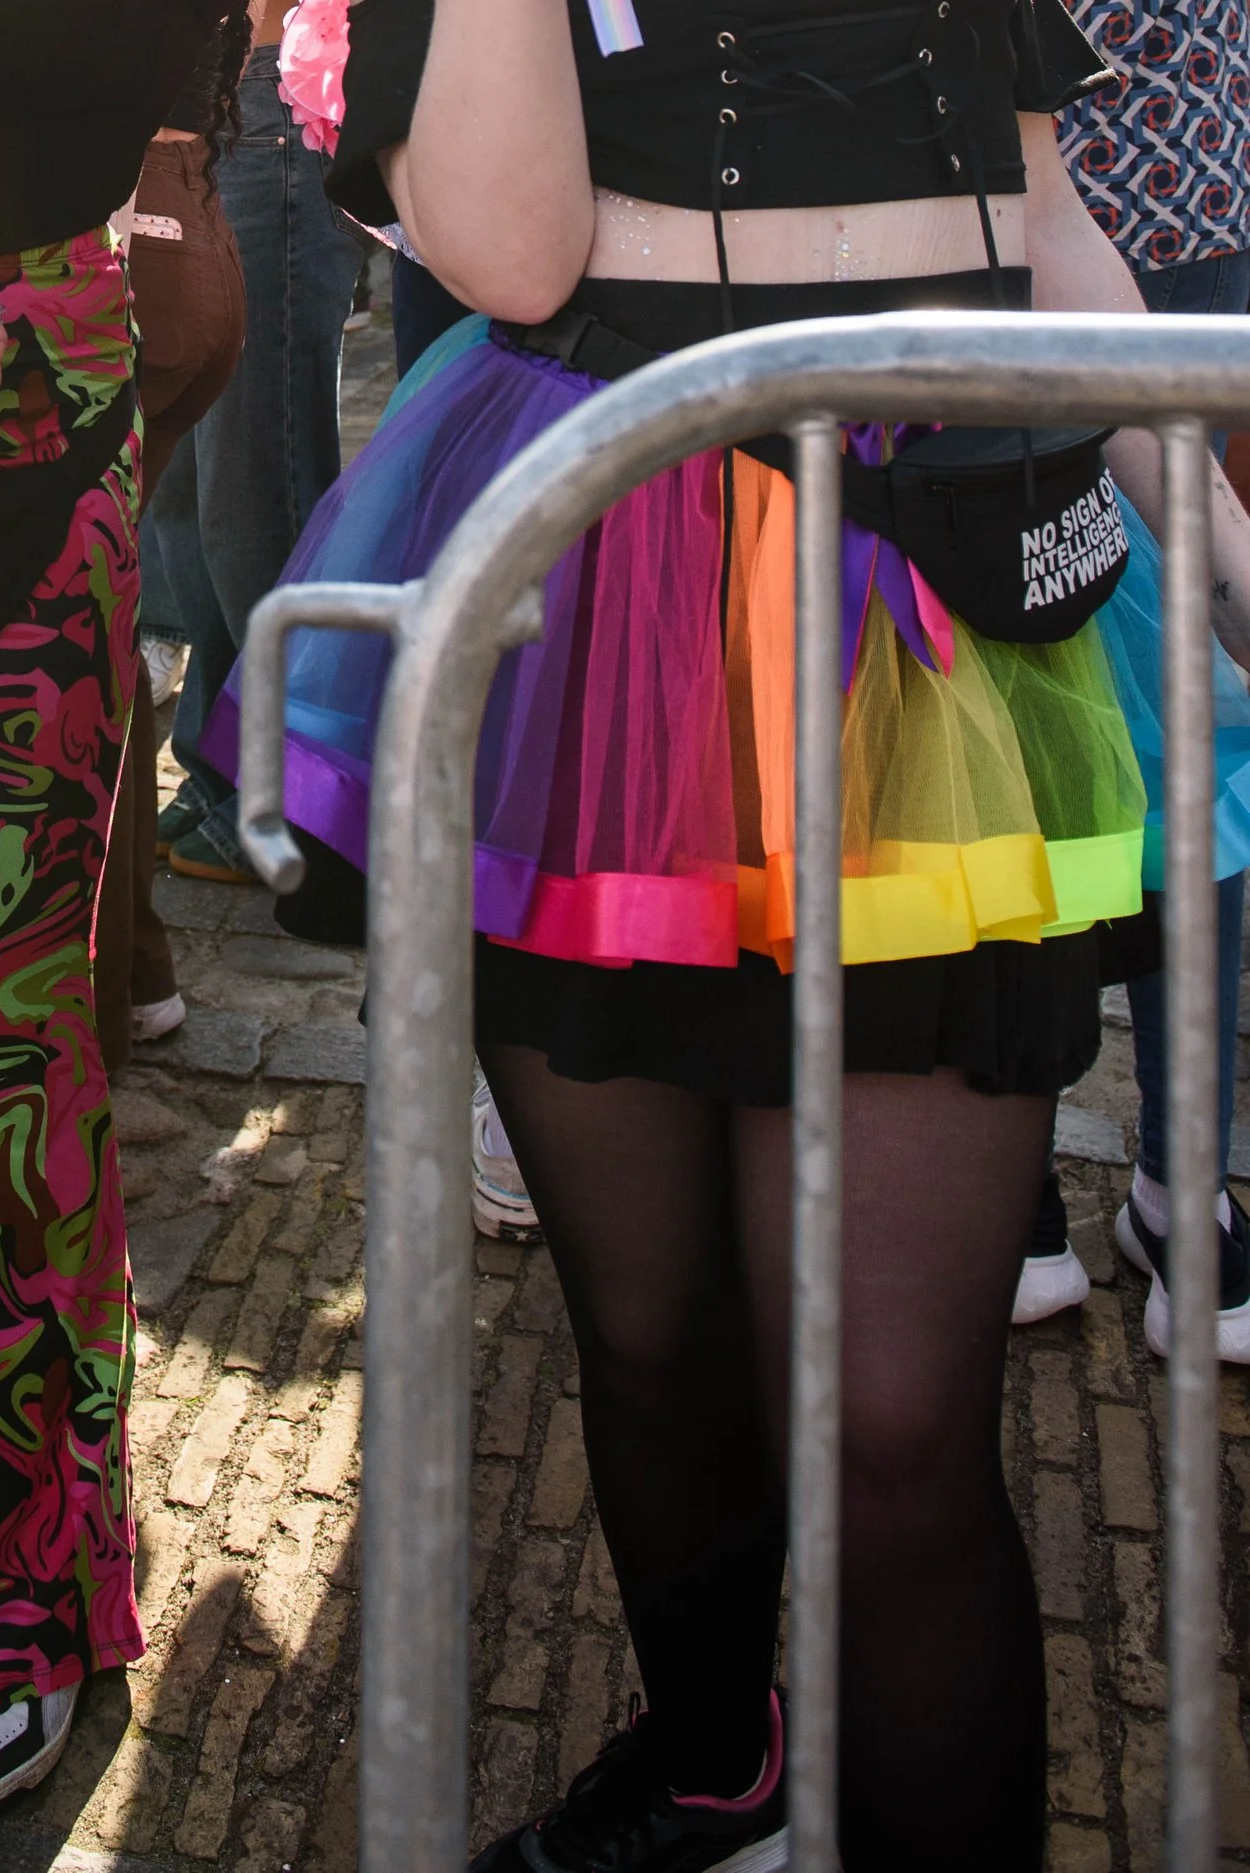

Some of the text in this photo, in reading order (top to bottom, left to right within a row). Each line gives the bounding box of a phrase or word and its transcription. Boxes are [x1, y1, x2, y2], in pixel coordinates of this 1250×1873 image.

[1022, 521, 1057, 559] NO
[1061, 488, 1101, 539] SIGN
[1023, 501, 1122, 582] INTELLIGENC
